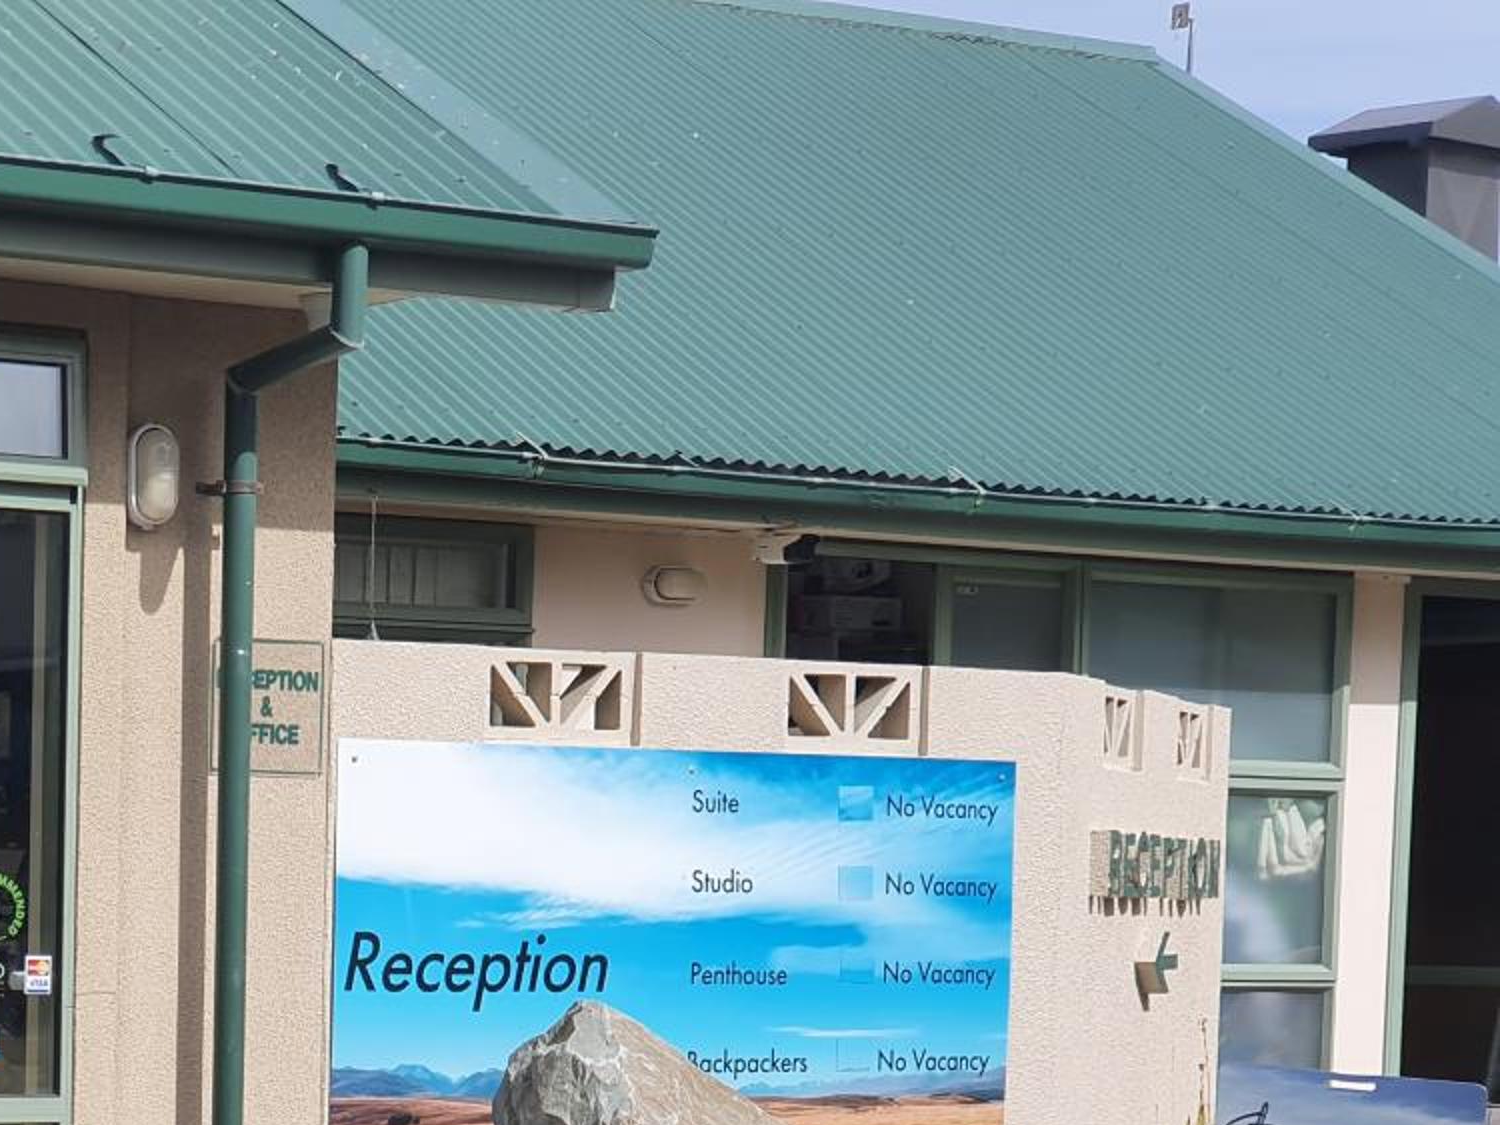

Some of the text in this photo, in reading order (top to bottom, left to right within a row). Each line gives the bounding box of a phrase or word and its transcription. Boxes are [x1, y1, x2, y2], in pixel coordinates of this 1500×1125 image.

[252, 670, 319, 691] EPTION
[260, 696, 273, 717] &
[251, 723, 299, 745] FFICE
[692, 789, 740, 814] Suite
[886, 794, 998, 826] No Vacancy
[691, 868, 753, 894] Studio
[885, 872, 997, 904] No Vacancy
[344, 931, 609, 1012] Reception
[691, 960, 788, 985] Penthouse
[883, 960, 996, 990] No Vacancy
[687, 1048, 808, 1079] Backpackers
[877, 1048, 990, 1076] No Vacancy
